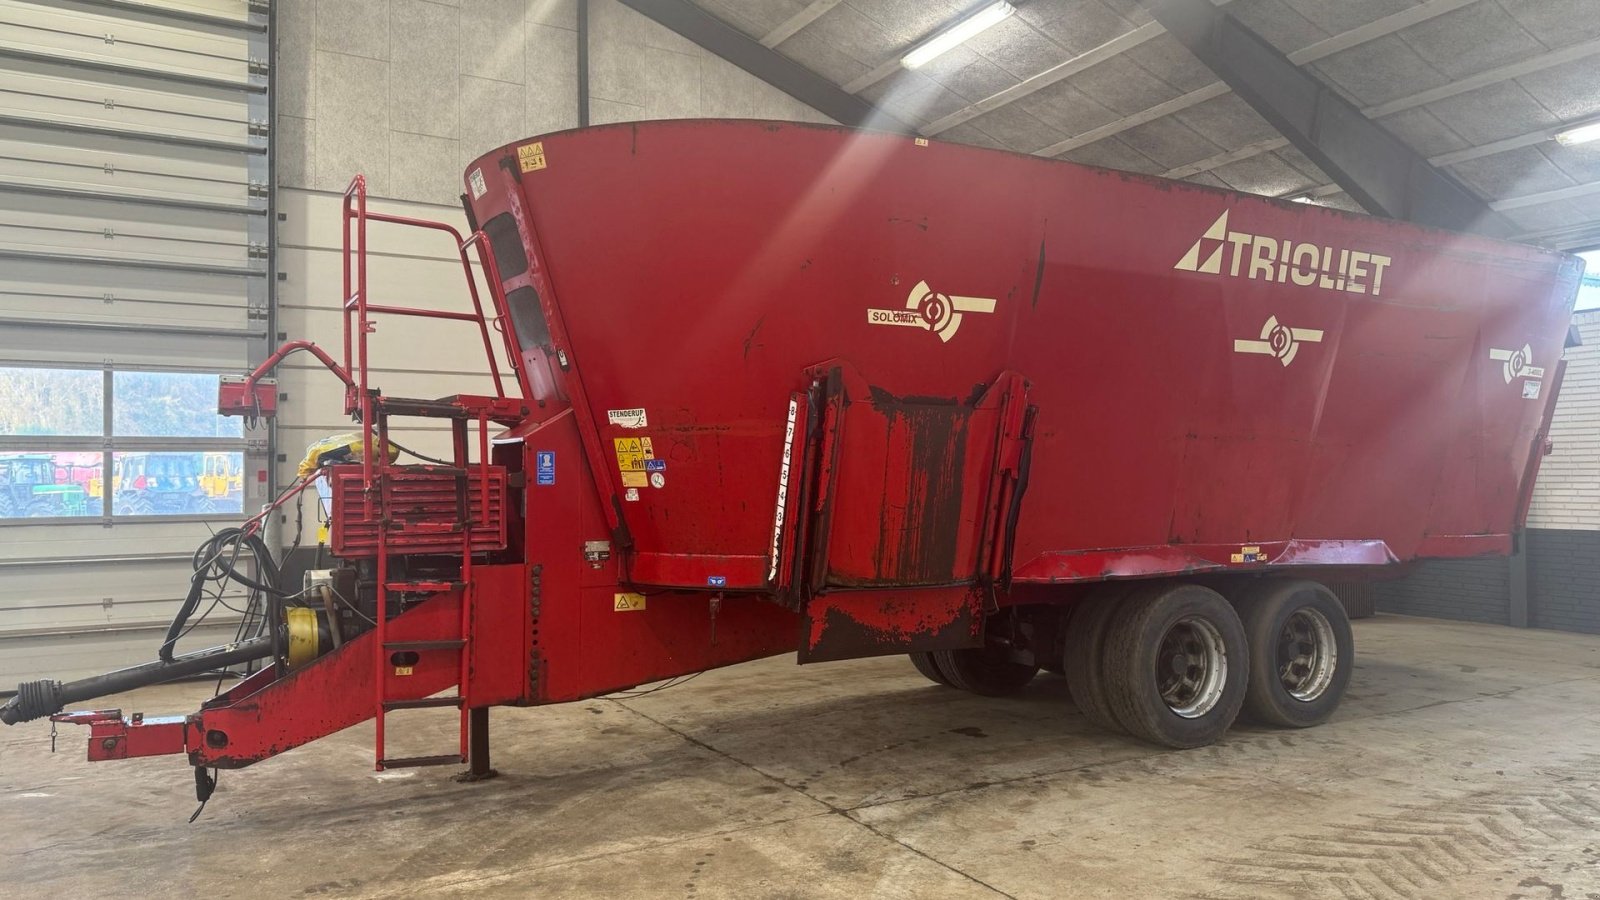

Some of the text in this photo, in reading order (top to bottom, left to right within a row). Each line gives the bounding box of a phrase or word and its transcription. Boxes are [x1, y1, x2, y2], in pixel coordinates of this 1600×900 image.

[1227, 231, 1392, 296] TRIOLIET
[872, 311, 917, 324] SOLOMIX
[610, 410, 643, 418] STENDERUP
[790, 406, 795, 416] 8
[788, 427, 793, 436] 7
[785, 449, 790, 458] 6
[782, 470, 787, 480] 5
